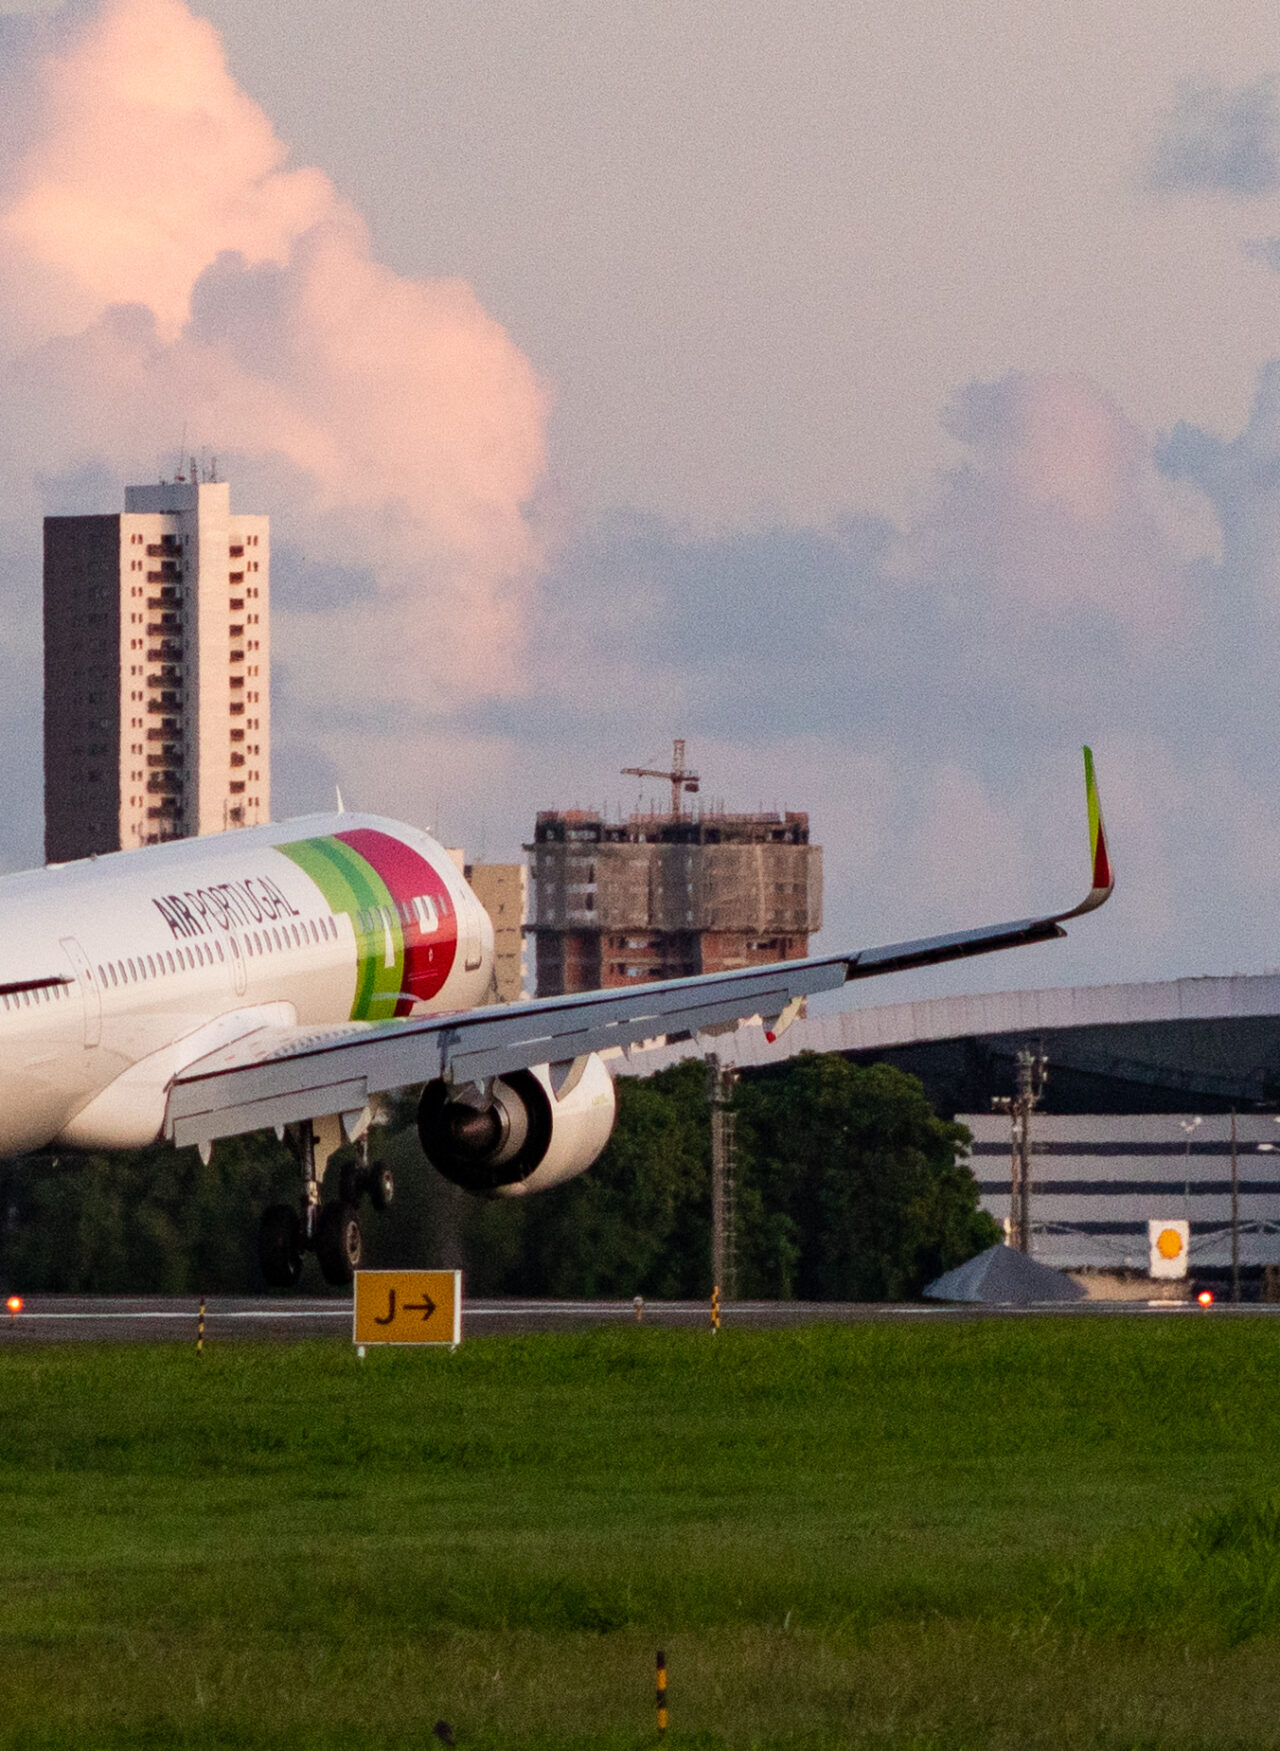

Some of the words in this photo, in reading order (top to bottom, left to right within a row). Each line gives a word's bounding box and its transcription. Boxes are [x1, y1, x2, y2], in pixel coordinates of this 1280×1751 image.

[152, 894, 205, 940] AIR
[184, 875, 300, 933] PORTUGAL
[374, 1289, 396, 1325] J
